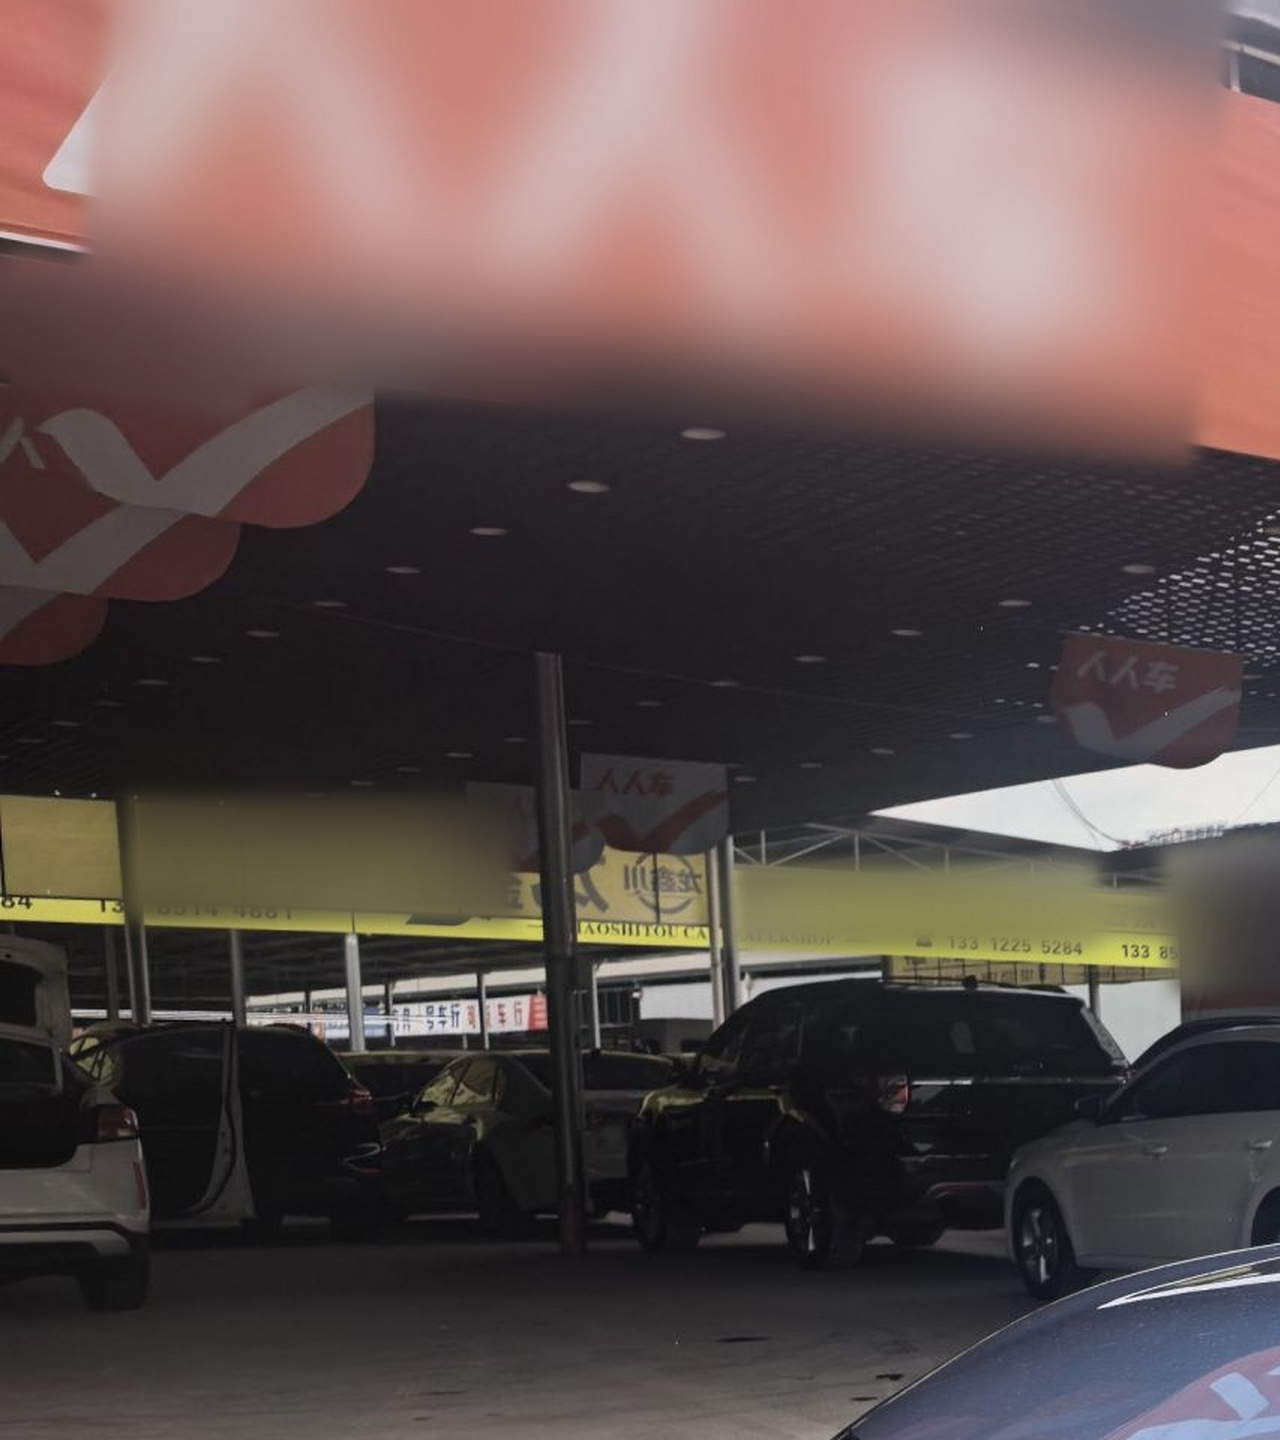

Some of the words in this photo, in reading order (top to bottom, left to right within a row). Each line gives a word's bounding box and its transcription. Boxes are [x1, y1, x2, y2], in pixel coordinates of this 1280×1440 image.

[1075, 649, 1180, 695] 人人车
[948, 936, 978, 950] 133
[990, 937, 1031, 953] 1225
[1042, 940, 1083, 956] 5284
[1121, 943, 1151, 960] 133
